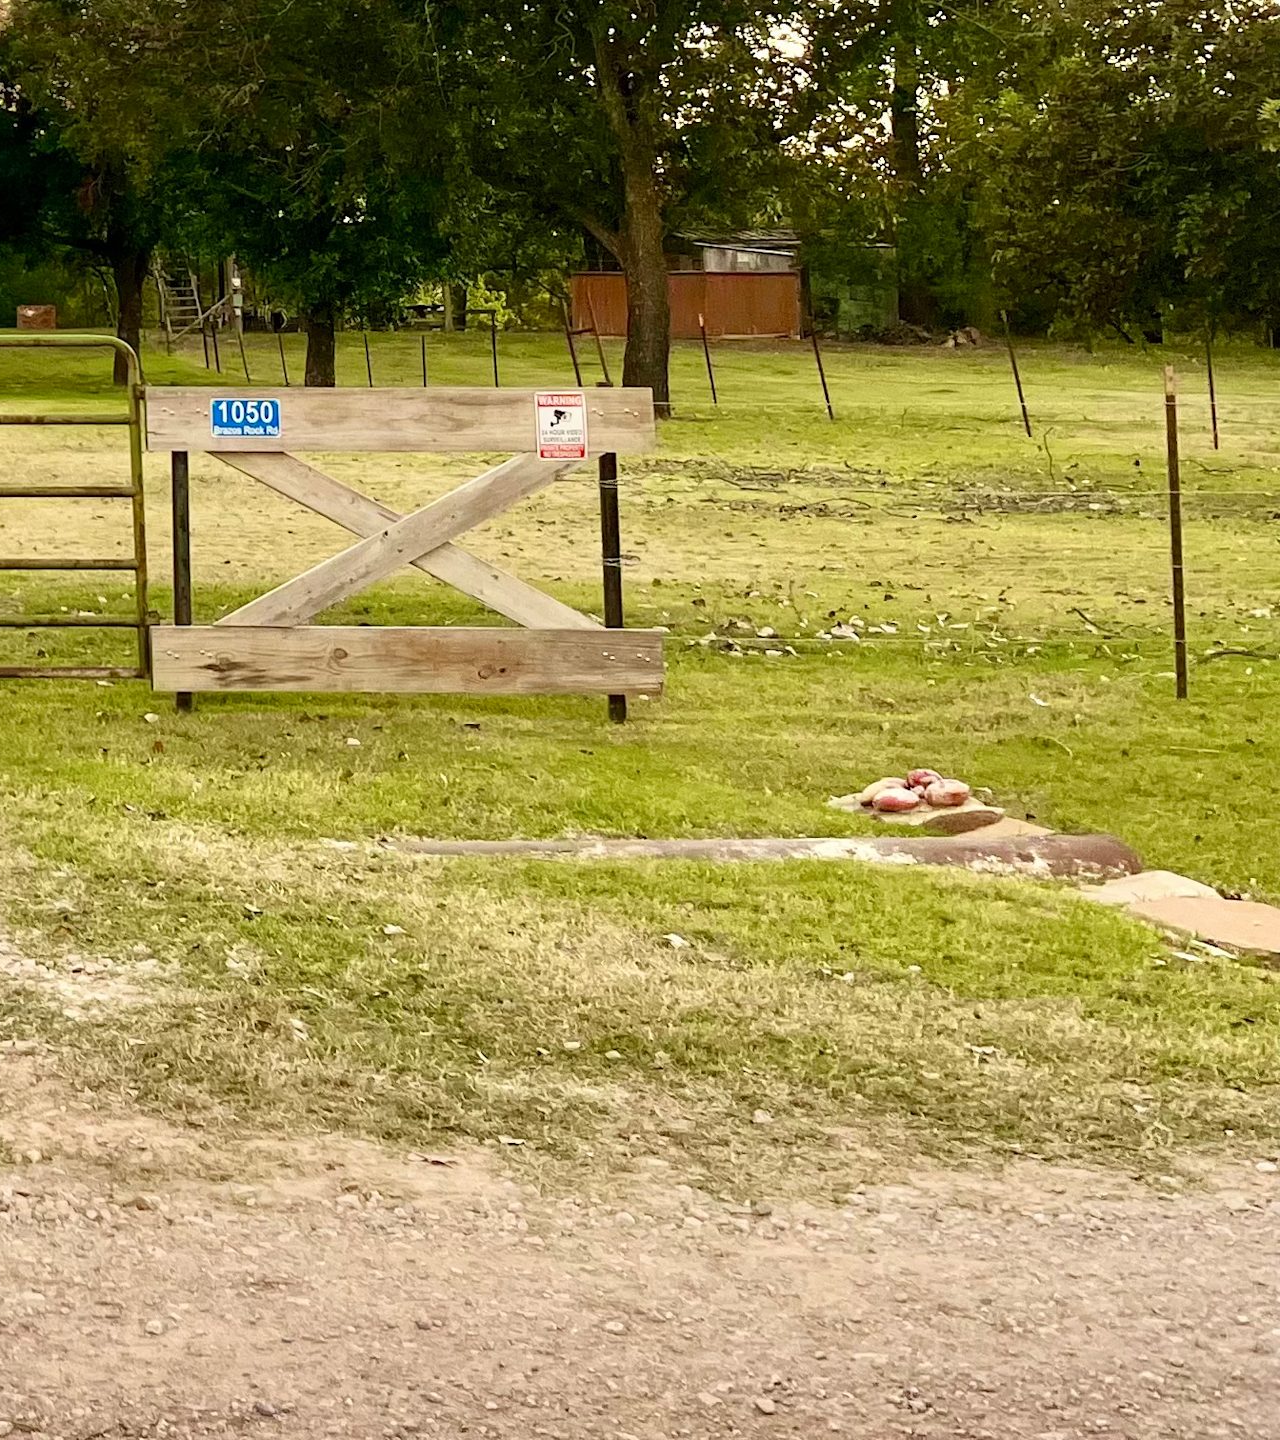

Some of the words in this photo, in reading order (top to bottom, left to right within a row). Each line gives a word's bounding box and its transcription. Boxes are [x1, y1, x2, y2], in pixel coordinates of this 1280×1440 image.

[538, 395, 582, 406] WARNING
[218, 401, 273, 424] 1050
[243, 425, 265, 435] Rock
[266, 425, 278, 435] Rd
